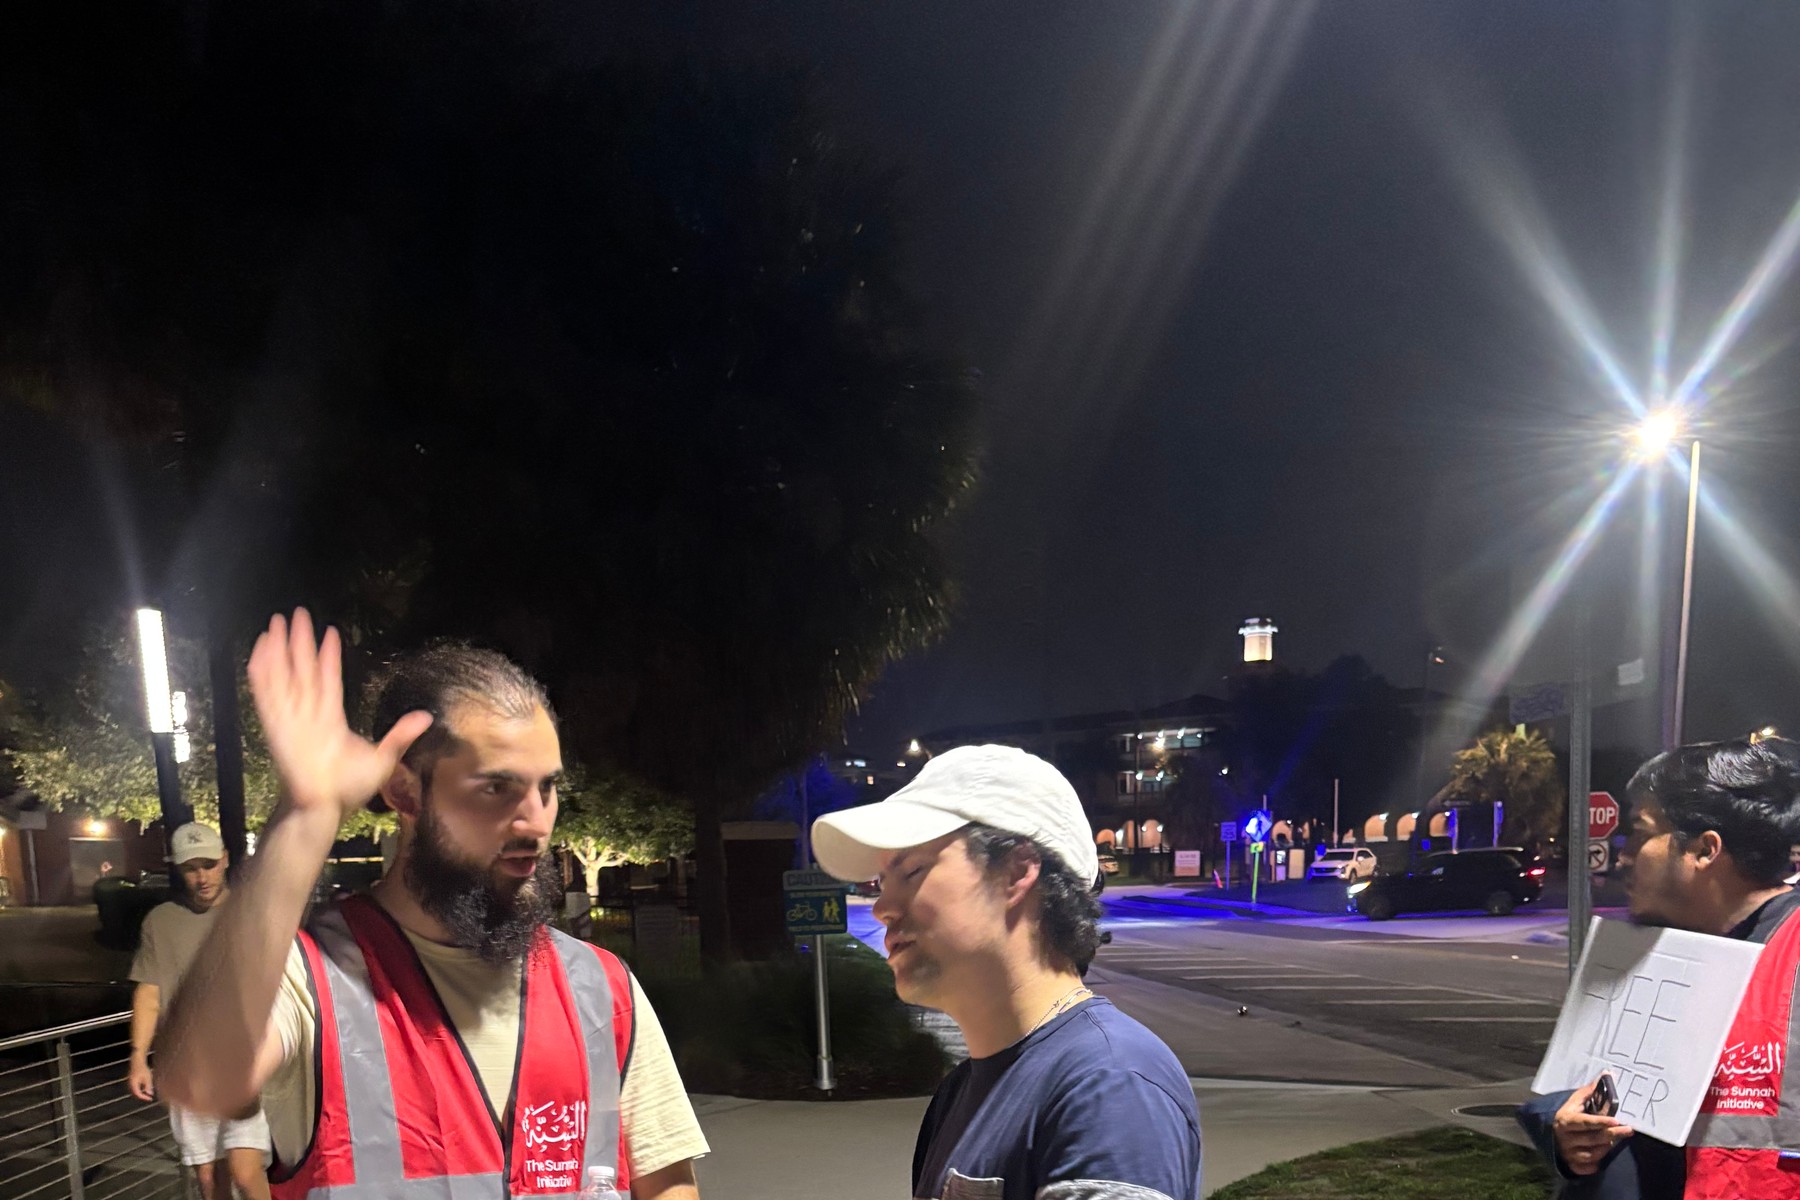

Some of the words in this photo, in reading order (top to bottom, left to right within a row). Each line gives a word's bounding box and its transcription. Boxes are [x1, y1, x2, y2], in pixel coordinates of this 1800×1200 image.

[1589, 806, 1616, 825] TOP
[1612, 1064, 1670, 1127] TER
[1711, 1086, 1730, 1097] The
[1731, 1085, 1776, 1098] Sunnah
[1717, 1098, 1764, 1109] Initiative
[525, 1160, 545, 1172] The
[537, 1174, 573, 1188] Initiativ
